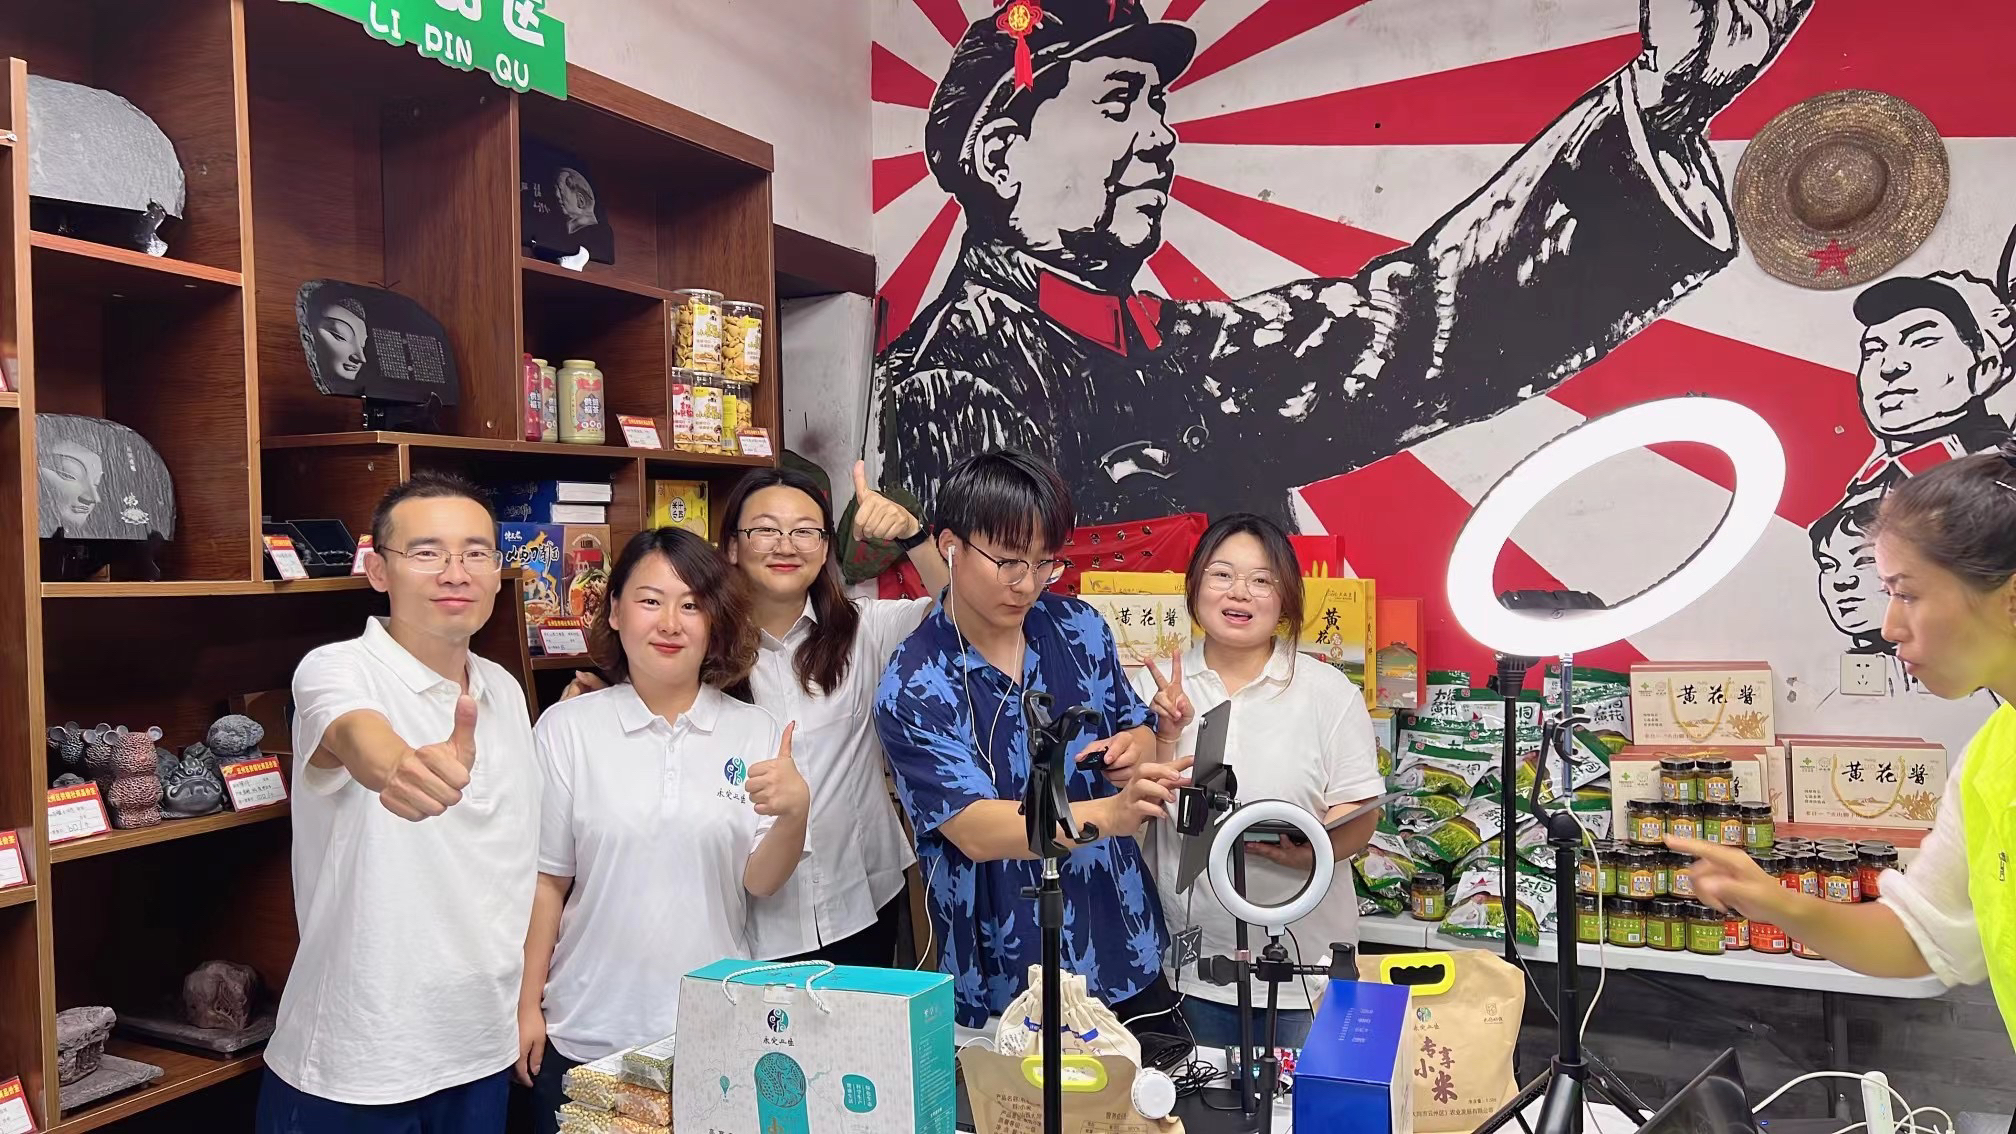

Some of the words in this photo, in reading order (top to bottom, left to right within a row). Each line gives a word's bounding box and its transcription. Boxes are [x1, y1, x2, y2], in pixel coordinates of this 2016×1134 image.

[370, 1, 401, 40] LI
[495, 53, 529, 88] QU
[1115, 607, 1179, 627] 黄花酱
[1315, 607, 1342, 645] 黄花
[1676, 684, 1756, 705] 黄花酱
[1841, 761, 1929, 785] 黄花酱
[1420, 1036, 1455, 1069] 专享
[1414, 1058, 1458, 1104] 小米
